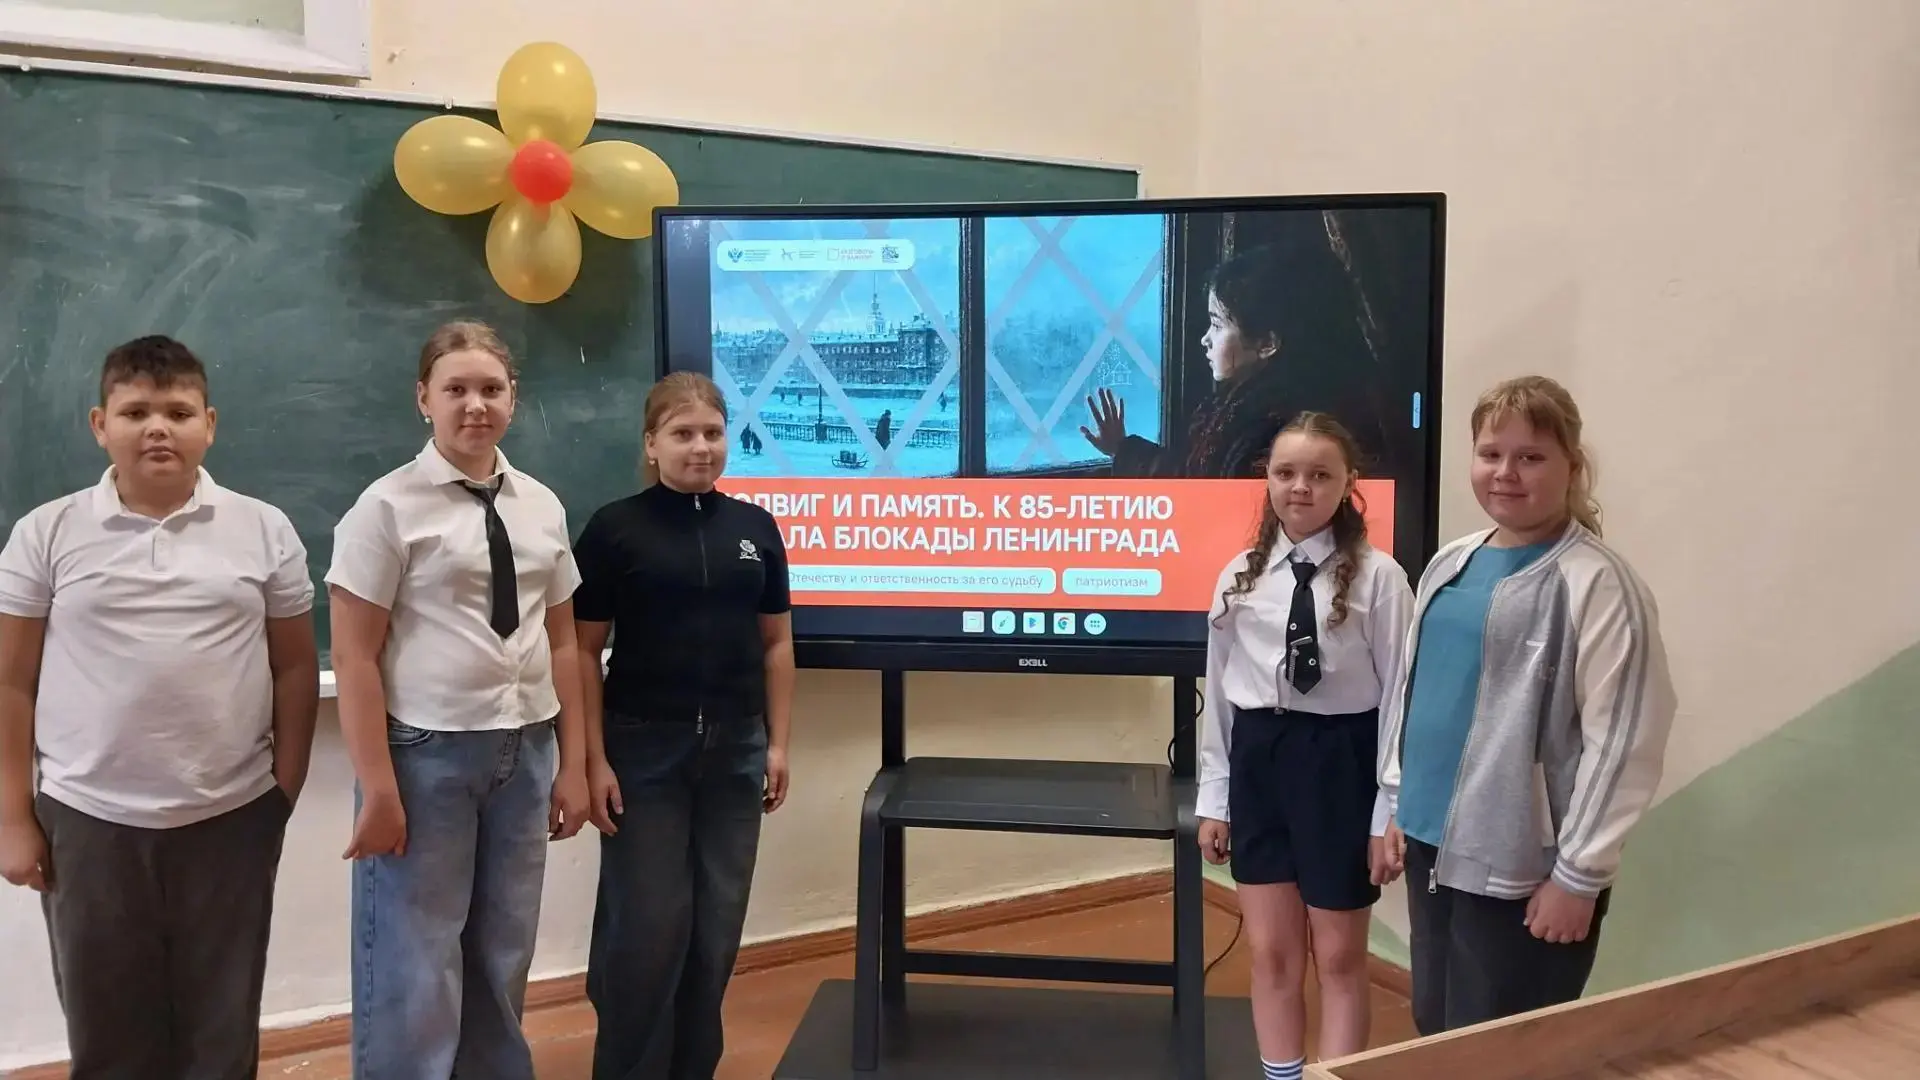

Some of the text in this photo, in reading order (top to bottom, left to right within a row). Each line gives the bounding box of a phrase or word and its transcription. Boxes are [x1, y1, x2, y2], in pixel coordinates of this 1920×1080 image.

[725, 493, 1174, 520] ДВИГ И ПАМЯТЬ. К 85-ЛЕТИЮ
[782, 525, 1181, 557] ЛА БЛОКАДЫ ЛЕНИНГРАДА
[850, 574, 858, 584] и
[861, 574, 960, 585] ответственность
[962, 575, 976, 585] за
[980, 576, 999, 585] его
[1001, 575, 1043, 588] судьбу
[1075, 576, 1149, 589] патриотизм
